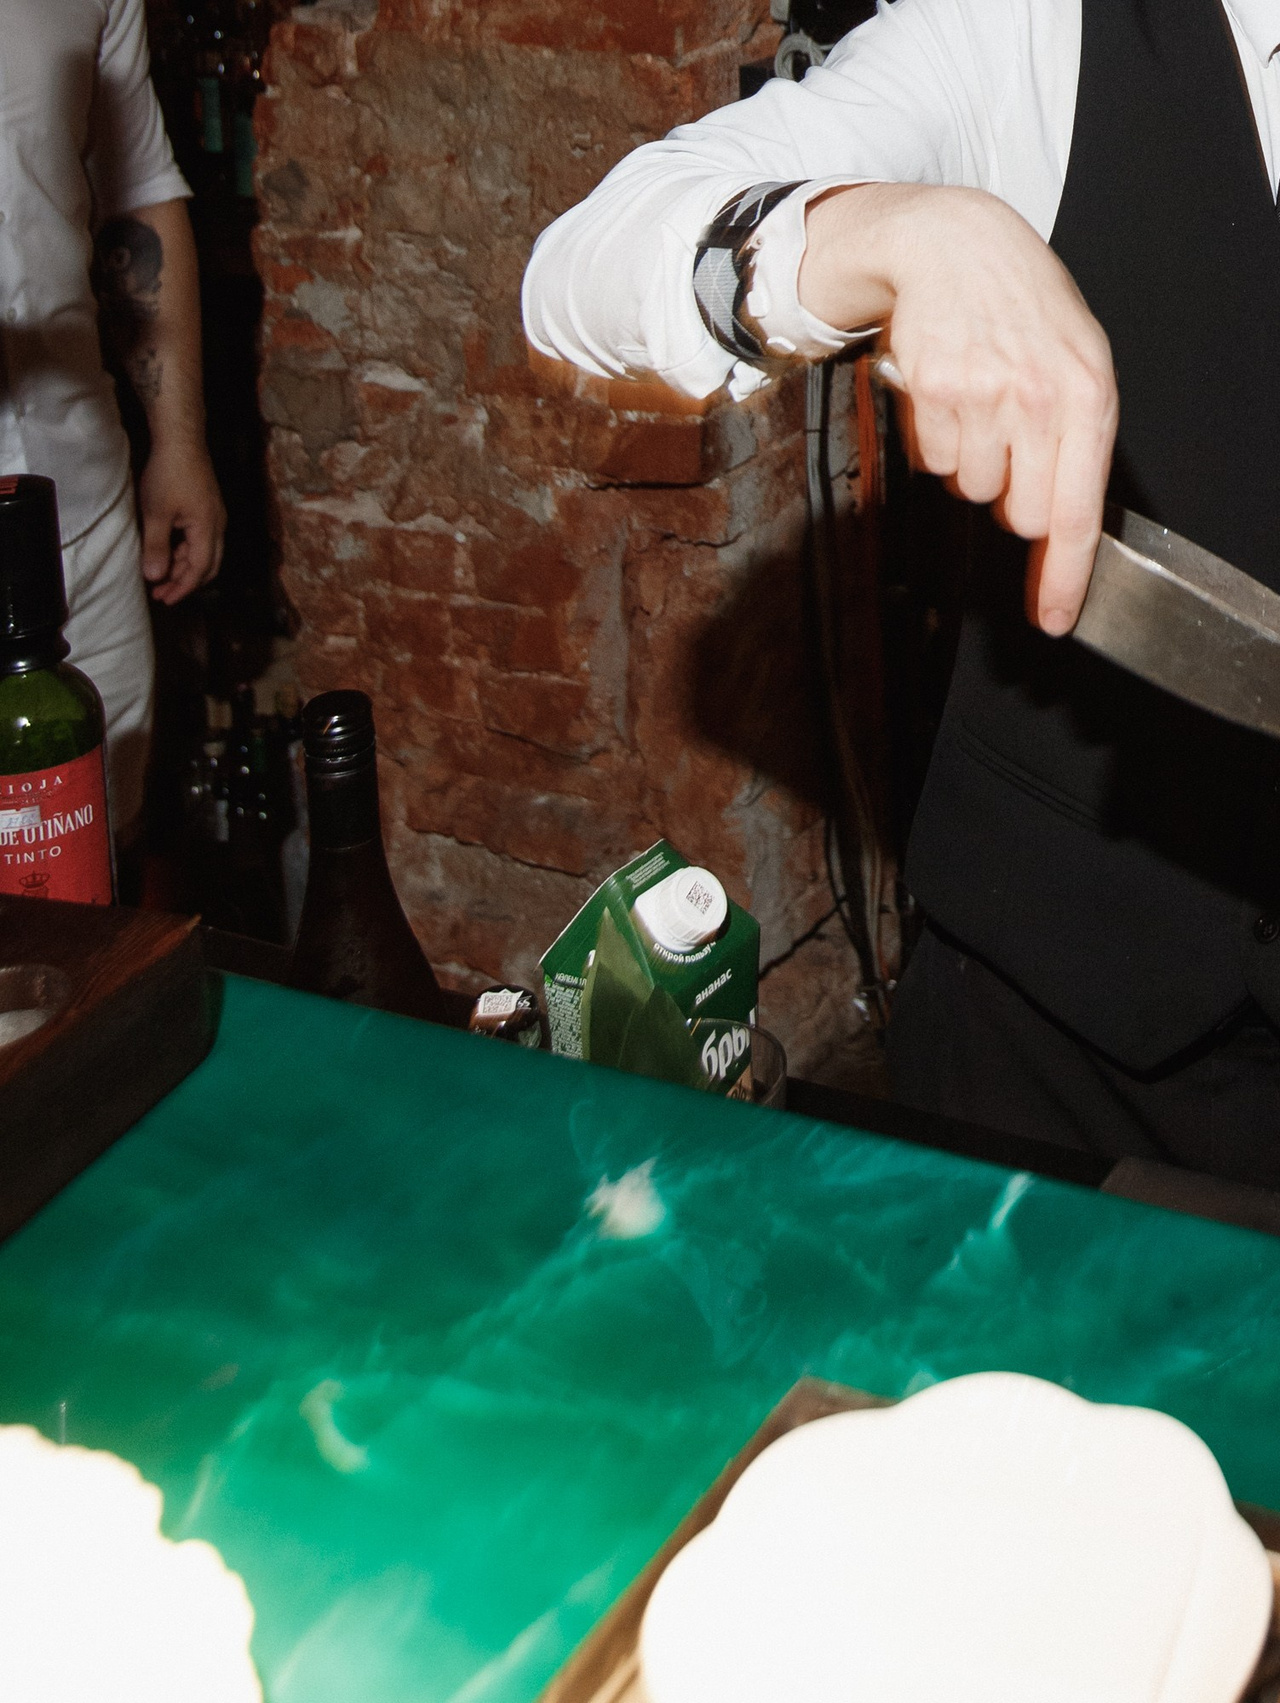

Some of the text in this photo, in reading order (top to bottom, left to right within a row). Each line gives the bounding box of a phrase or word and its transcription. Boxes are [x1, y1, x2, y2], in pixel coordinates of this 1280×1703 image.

[0, 775, 62, 794] IOJA
[24, 804, 93, 844] UTIÑANO
[4, 846, 62, 865] TINTO
[695, 968, 732, 1006] ананас
